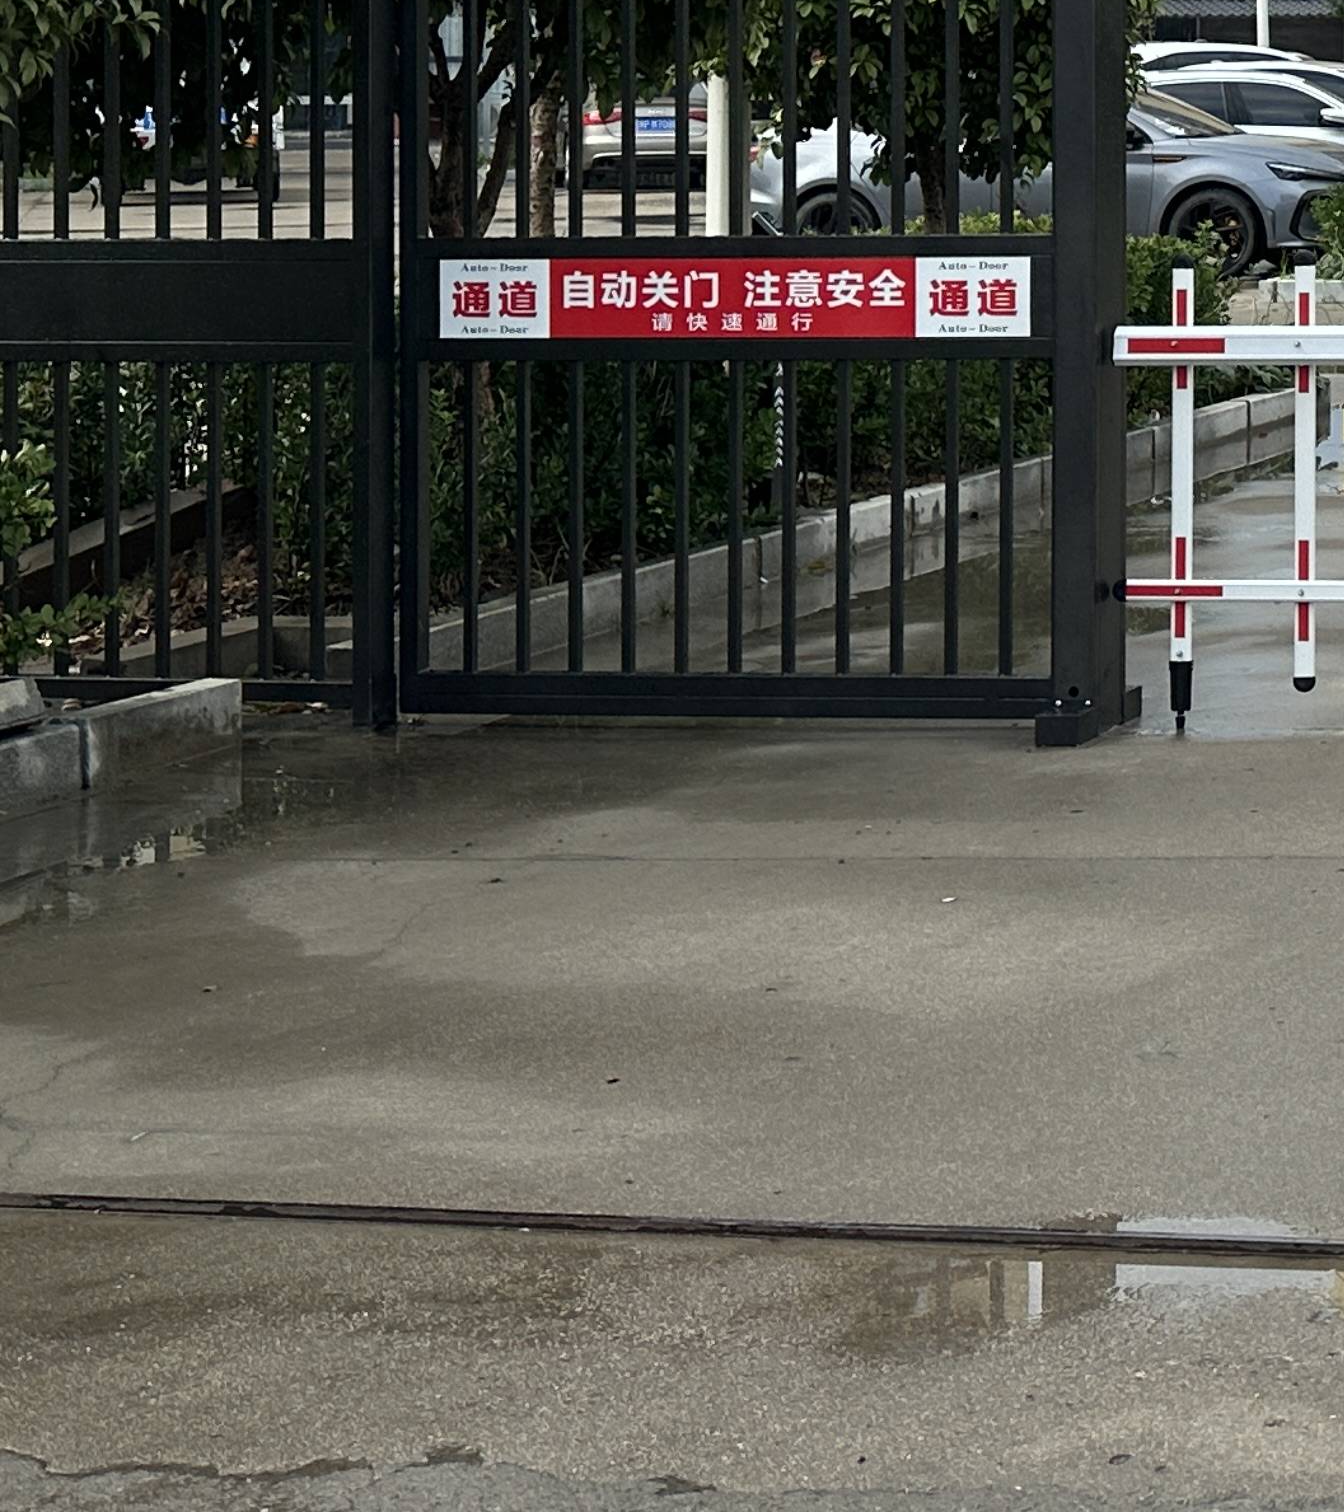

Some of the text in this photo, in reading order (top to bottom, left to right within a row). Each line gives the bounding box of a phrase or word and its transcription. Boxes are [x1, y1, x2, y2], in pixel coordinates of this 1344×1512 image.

[451, 280, 538, 319] 通道
[562, 269, 906, 309] 自动关门 注意安全
[929, 278, 1018, 317] 通道
[651, 312, 813, 332] 请快速通行
